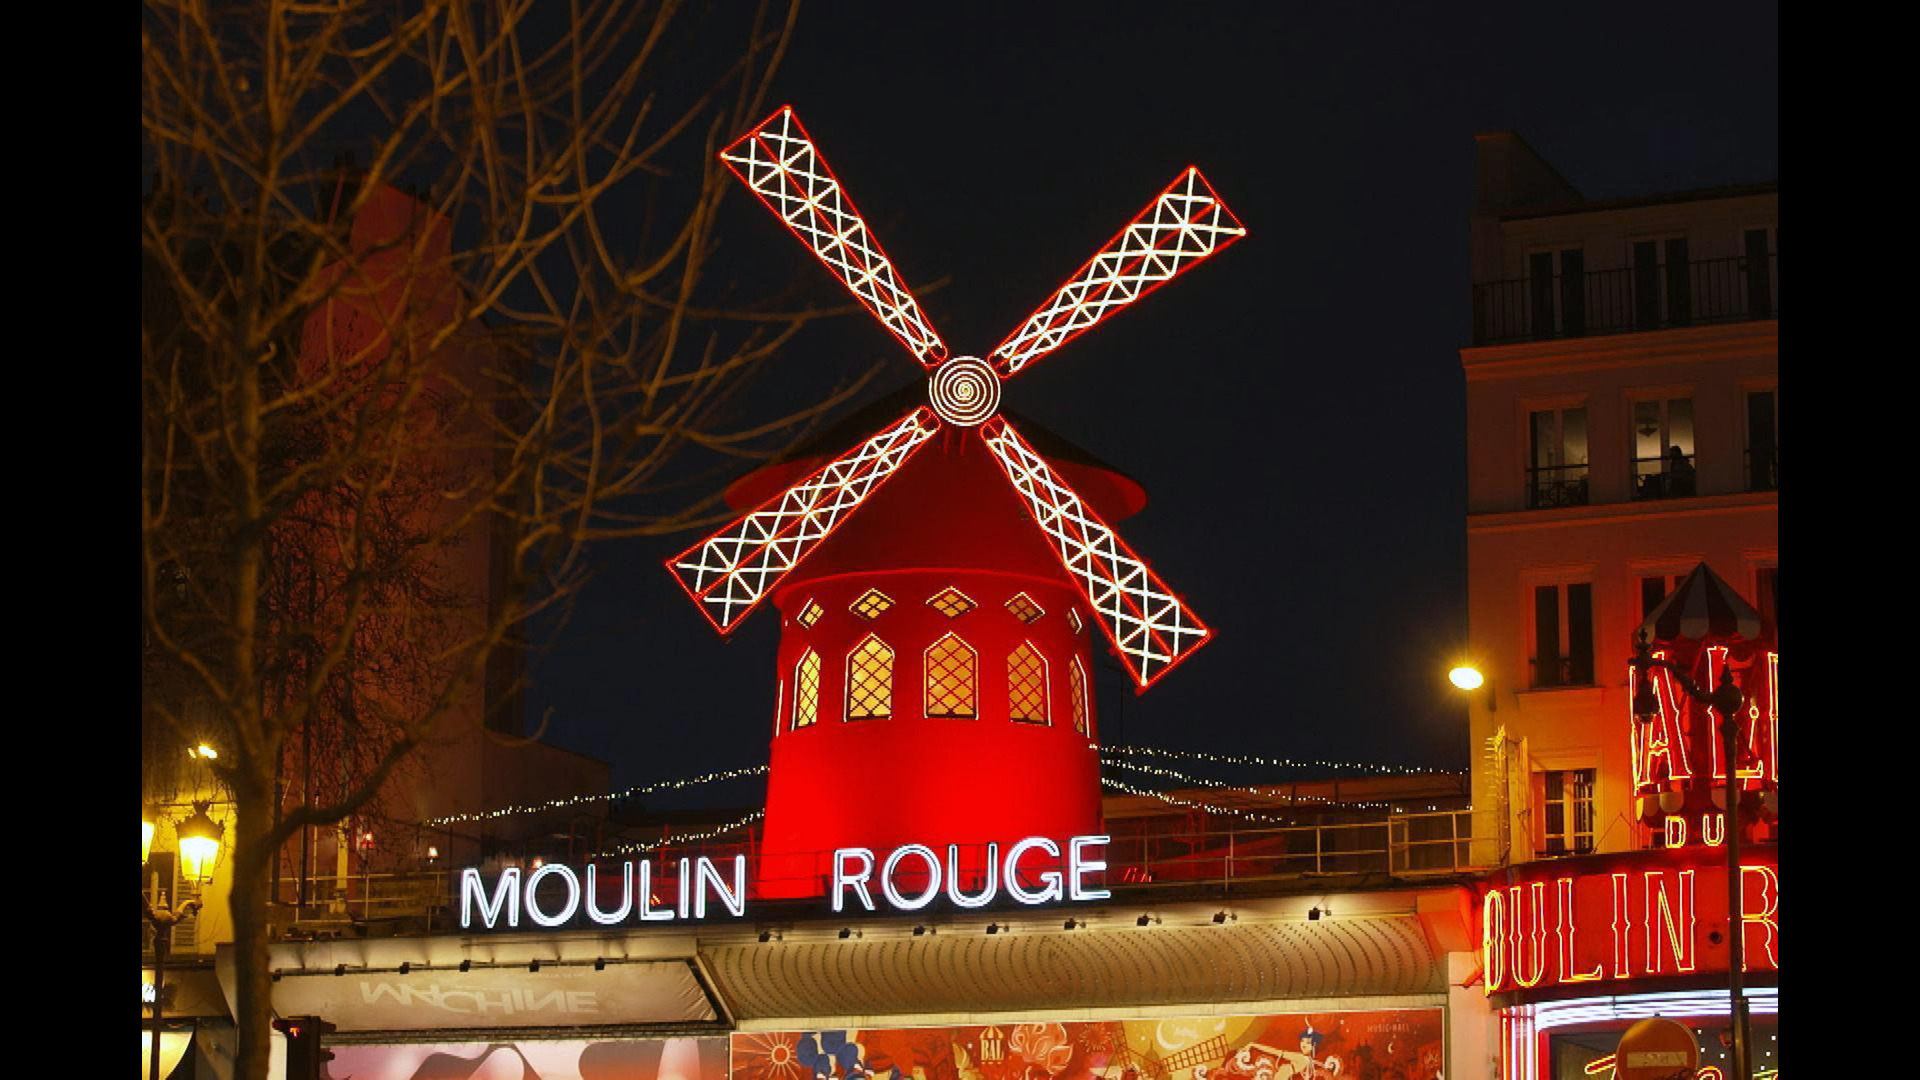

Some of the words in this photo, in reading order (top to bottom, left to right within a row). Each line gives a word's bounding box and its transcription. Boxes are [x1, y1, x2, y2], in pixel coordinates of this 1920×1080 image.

[1664, 814, 1725, 849] DU
[460, 855, 746, 929] MOULIN
[832, 835, 1111, 912] ROUGE
[980, 1039, 1005, 1061] BAL
